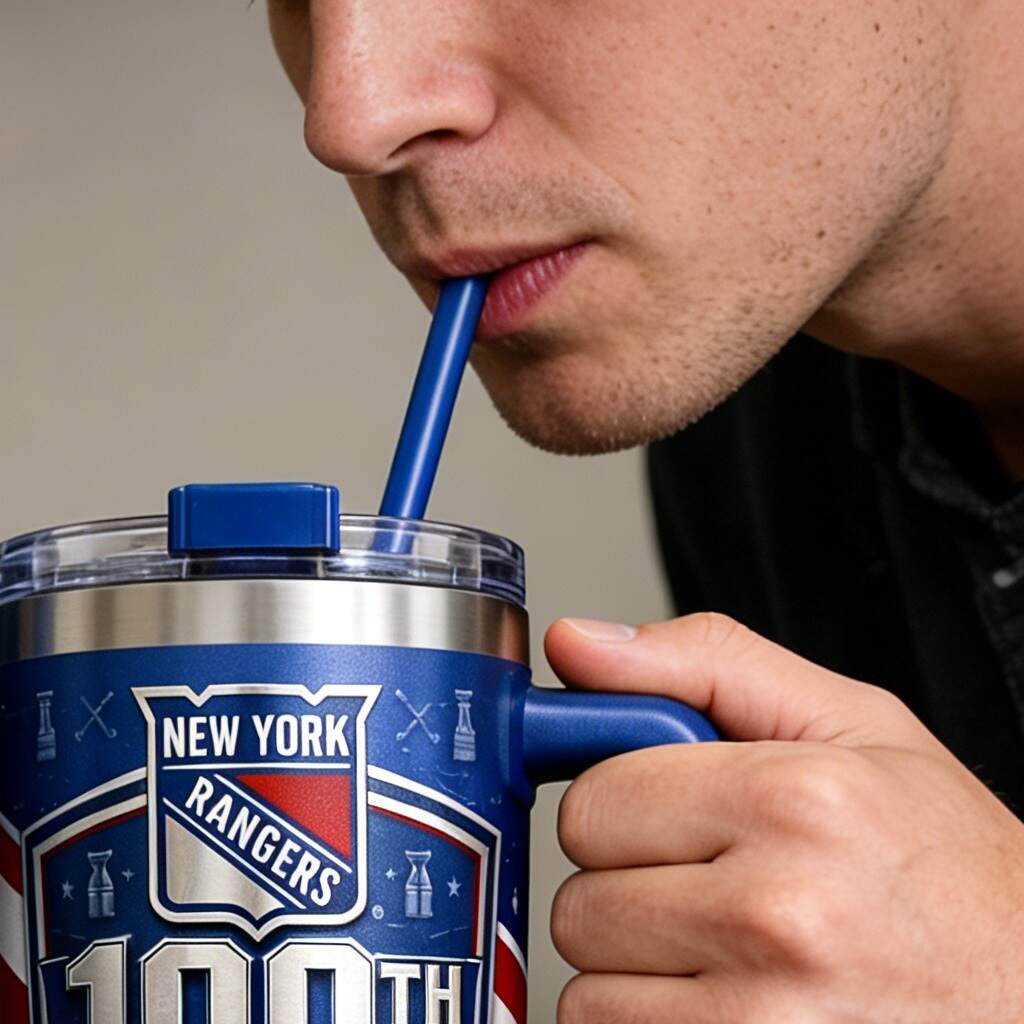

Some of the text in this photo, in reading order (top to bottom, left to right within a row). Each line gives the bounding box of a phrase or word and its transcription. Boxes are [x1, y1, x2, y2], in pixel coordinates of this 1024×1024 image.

[163, 713, 350, 758] NEW YORK
[184, 776, 341, 908] RANGERS
